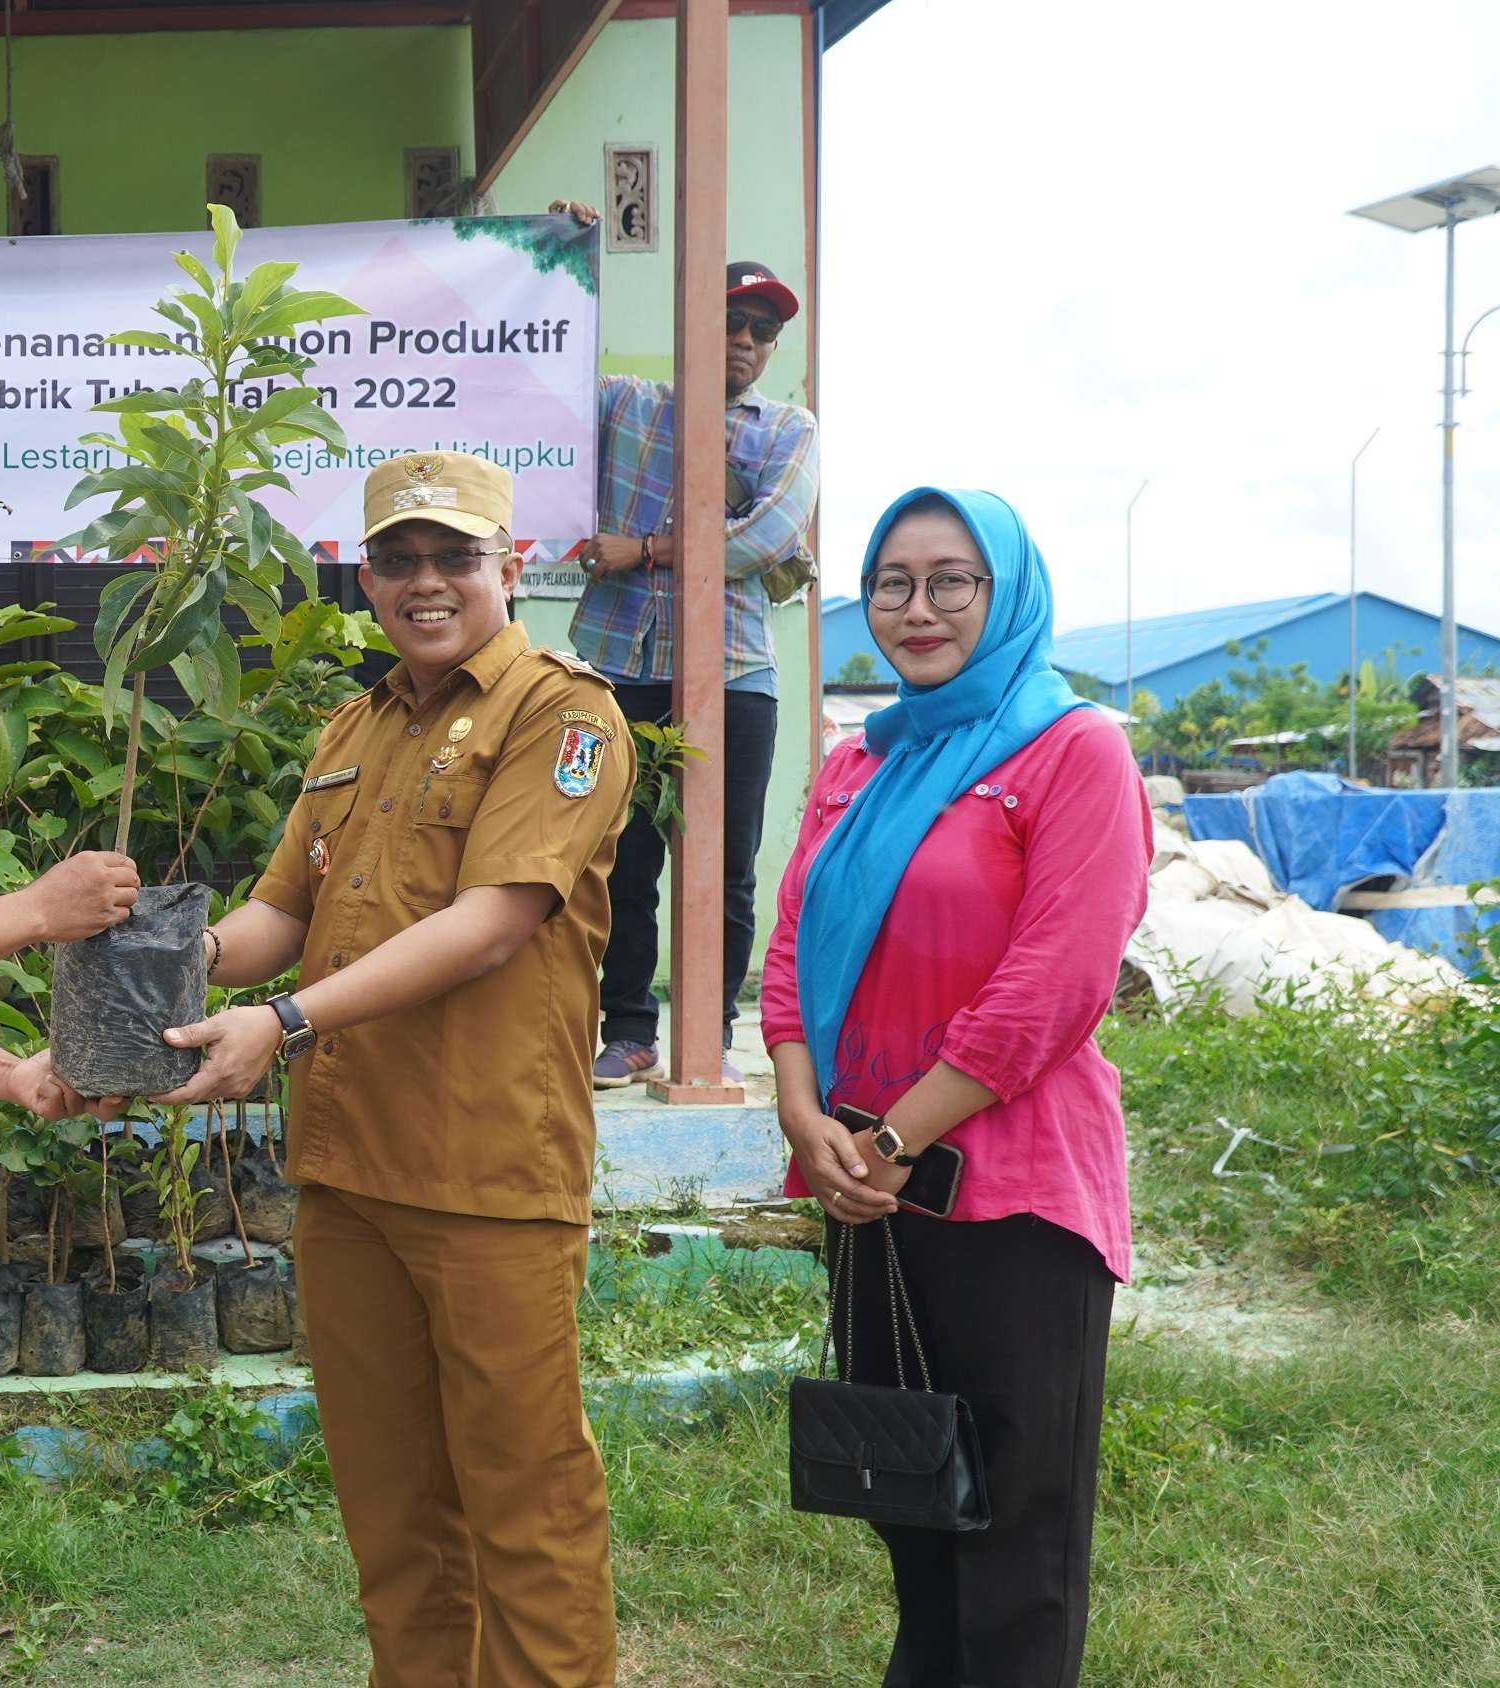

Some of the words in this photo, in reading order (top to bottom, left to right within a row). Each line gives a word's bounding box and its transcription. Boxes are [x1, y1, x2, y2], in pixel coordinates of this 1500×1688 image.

[369, 319, 571, 355] Produktif
[226, 378, 338, 409] Tahn
[353, 376, 457, 409] 2022
[3, 442, 110, 470] Lestari
